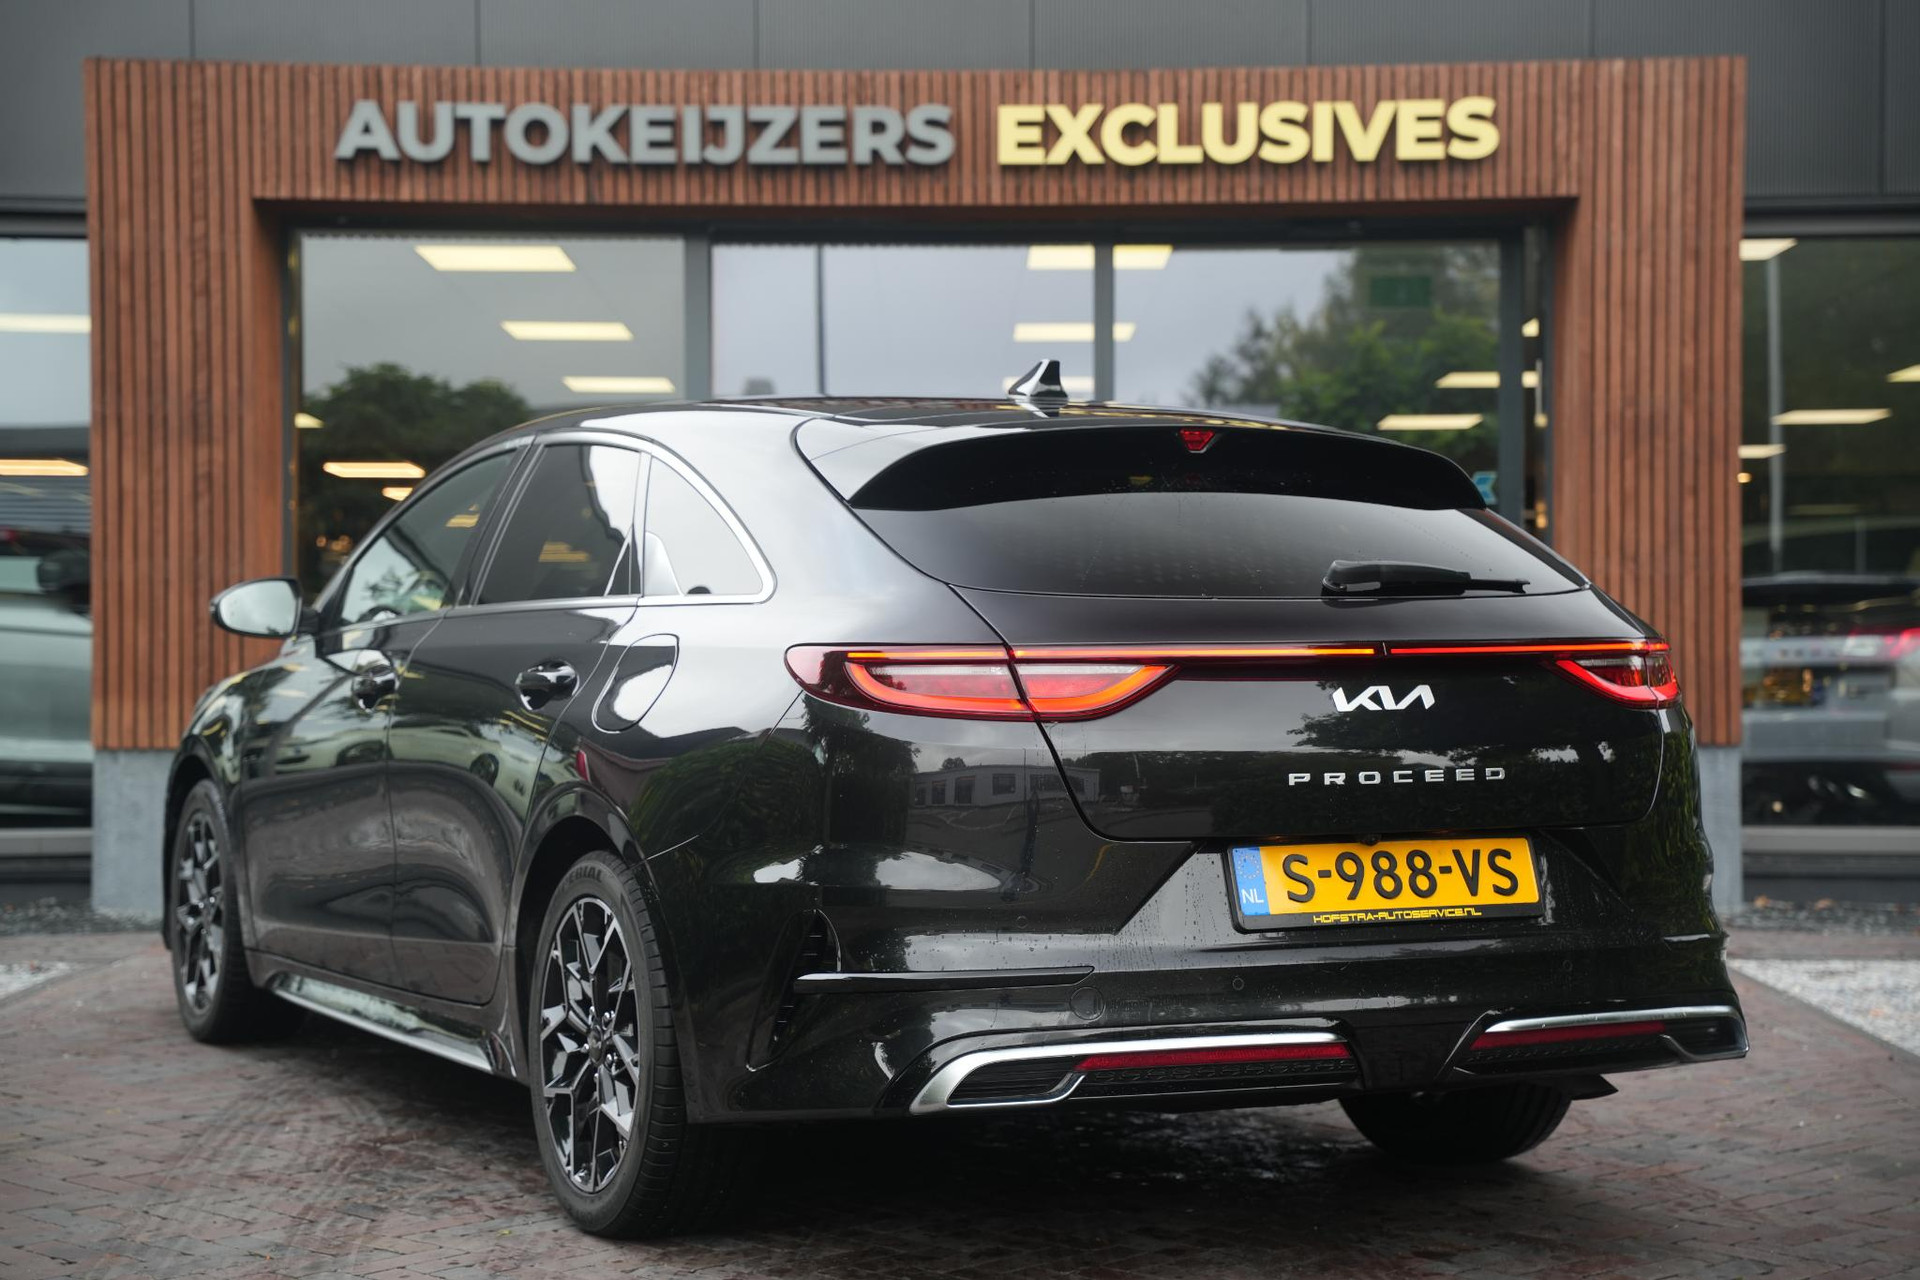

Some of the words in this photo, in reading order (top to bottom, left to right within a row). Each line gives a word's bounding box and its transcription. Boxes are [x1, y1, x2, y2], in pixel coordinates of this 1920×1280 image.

[334, 99, 956, 165] AUTOKEIJZERS
[997, 95, 1501, 166] EXCLUSIVES
[1332, 684, 1436, 713] KIA
[1288, 766, 1506, 786] PROCEED
[1282, 848, 1519, 903] S-988-VS
[1241, 888, 1265, 905] NL
